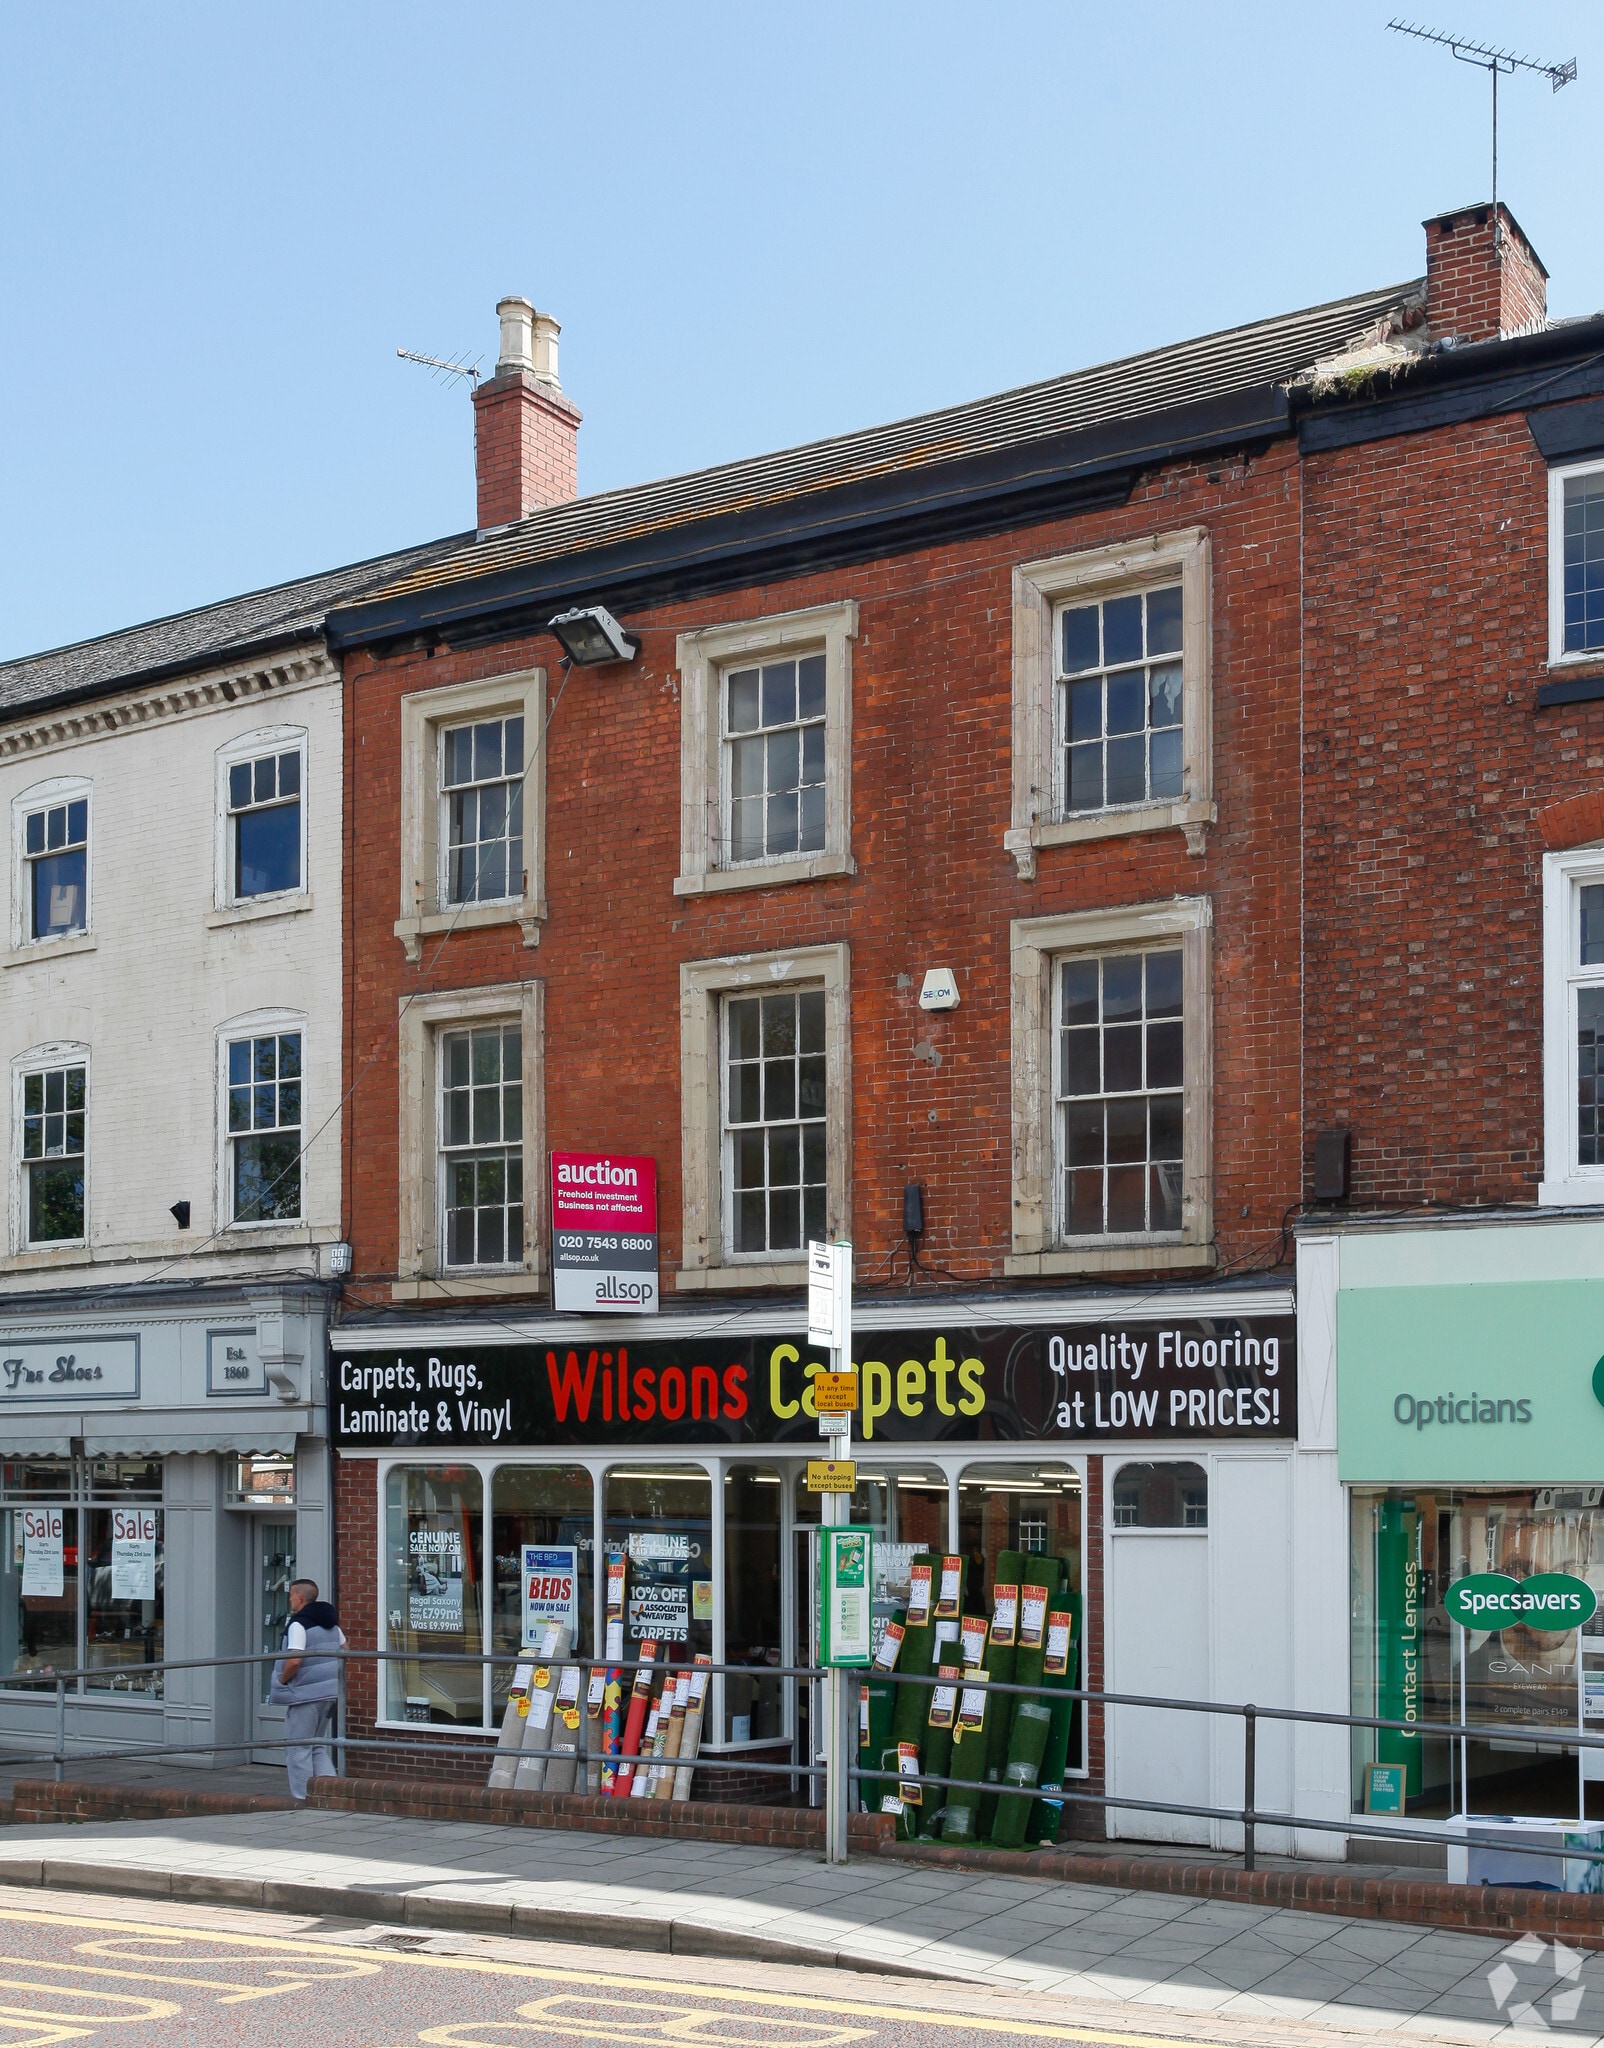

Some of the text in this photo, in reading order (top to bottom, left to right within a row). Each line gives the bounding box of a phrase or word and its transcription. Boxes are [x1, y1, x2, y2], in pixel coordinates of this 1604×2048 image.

[601, 615, 612, 626] 12
[923, 988, 950, 998] SECOM
[557, 1160, 638, 1186] auction
[558, 1190, 638, 1202] Freehold investment
[558, 1201, 642, 1212] Business not affected
[559, 1236, 652, 1250] 020 7543 6800
[560, 1253, 600, 1262] allsop.co.uk
[596, 1276, 652, 1304] allsop
[226, 1347, 247, 1360] Est.
[1048, 1330, 1279, 1380] Quality Flooring
[48, 1354, 103, 1383] Shoes
[224, 1366, 249, 1380] 1860
[340, 1357, 483, 1398] Carpets, Rugs,
[545, 1347, 748, 1422] Wilsons
[828, 1386, 839, 1394] any
[818, 1400, 854, 1408] local buses
[1056, 1388, 1280, 1428] at LOW PRICES!
[1394, 1392, 1532, 1431] Opticians
[339, 1398, 512, 1440] Laminate & Vinyl
[25, 1510, 62, 1538] Sale
[114, 1512, 154, 1540] Sale
[410, 1532, 460, 1544] GENUINE
[410, 1544, 460, 1552] SALE NOW ON
[530, 1552, 558, 1560] THE BED
[528, 1577, 572, 1600] BEDS
[630, 1586, 686, 1602] 10% OFF
[410, 1597, 460, 1607] Regal Saxony
[530, 1602, 570, 1612] NOW ON SALE
[1401, 1561, 1418, 1640] Lenses
[1460, 1588, 1581, 1614] Specsavers
[644, 1604, 686, 1613] ASSOCIATED
[644, 1612, 677, 1620] WEAVERS
[410, 1621, 428, 1630] Was
[630, 1627, 688, 1641] CARPETS
[1488, 1662, 1574, 1675] GANT
[1513, 1682, 1547, 1690] EYEWEAR
[1500, 1706, 1531, 1715] complete
[1532, 1706, 1550, 1716] pairs
[1551, 1708, 1568, 1716] £149
